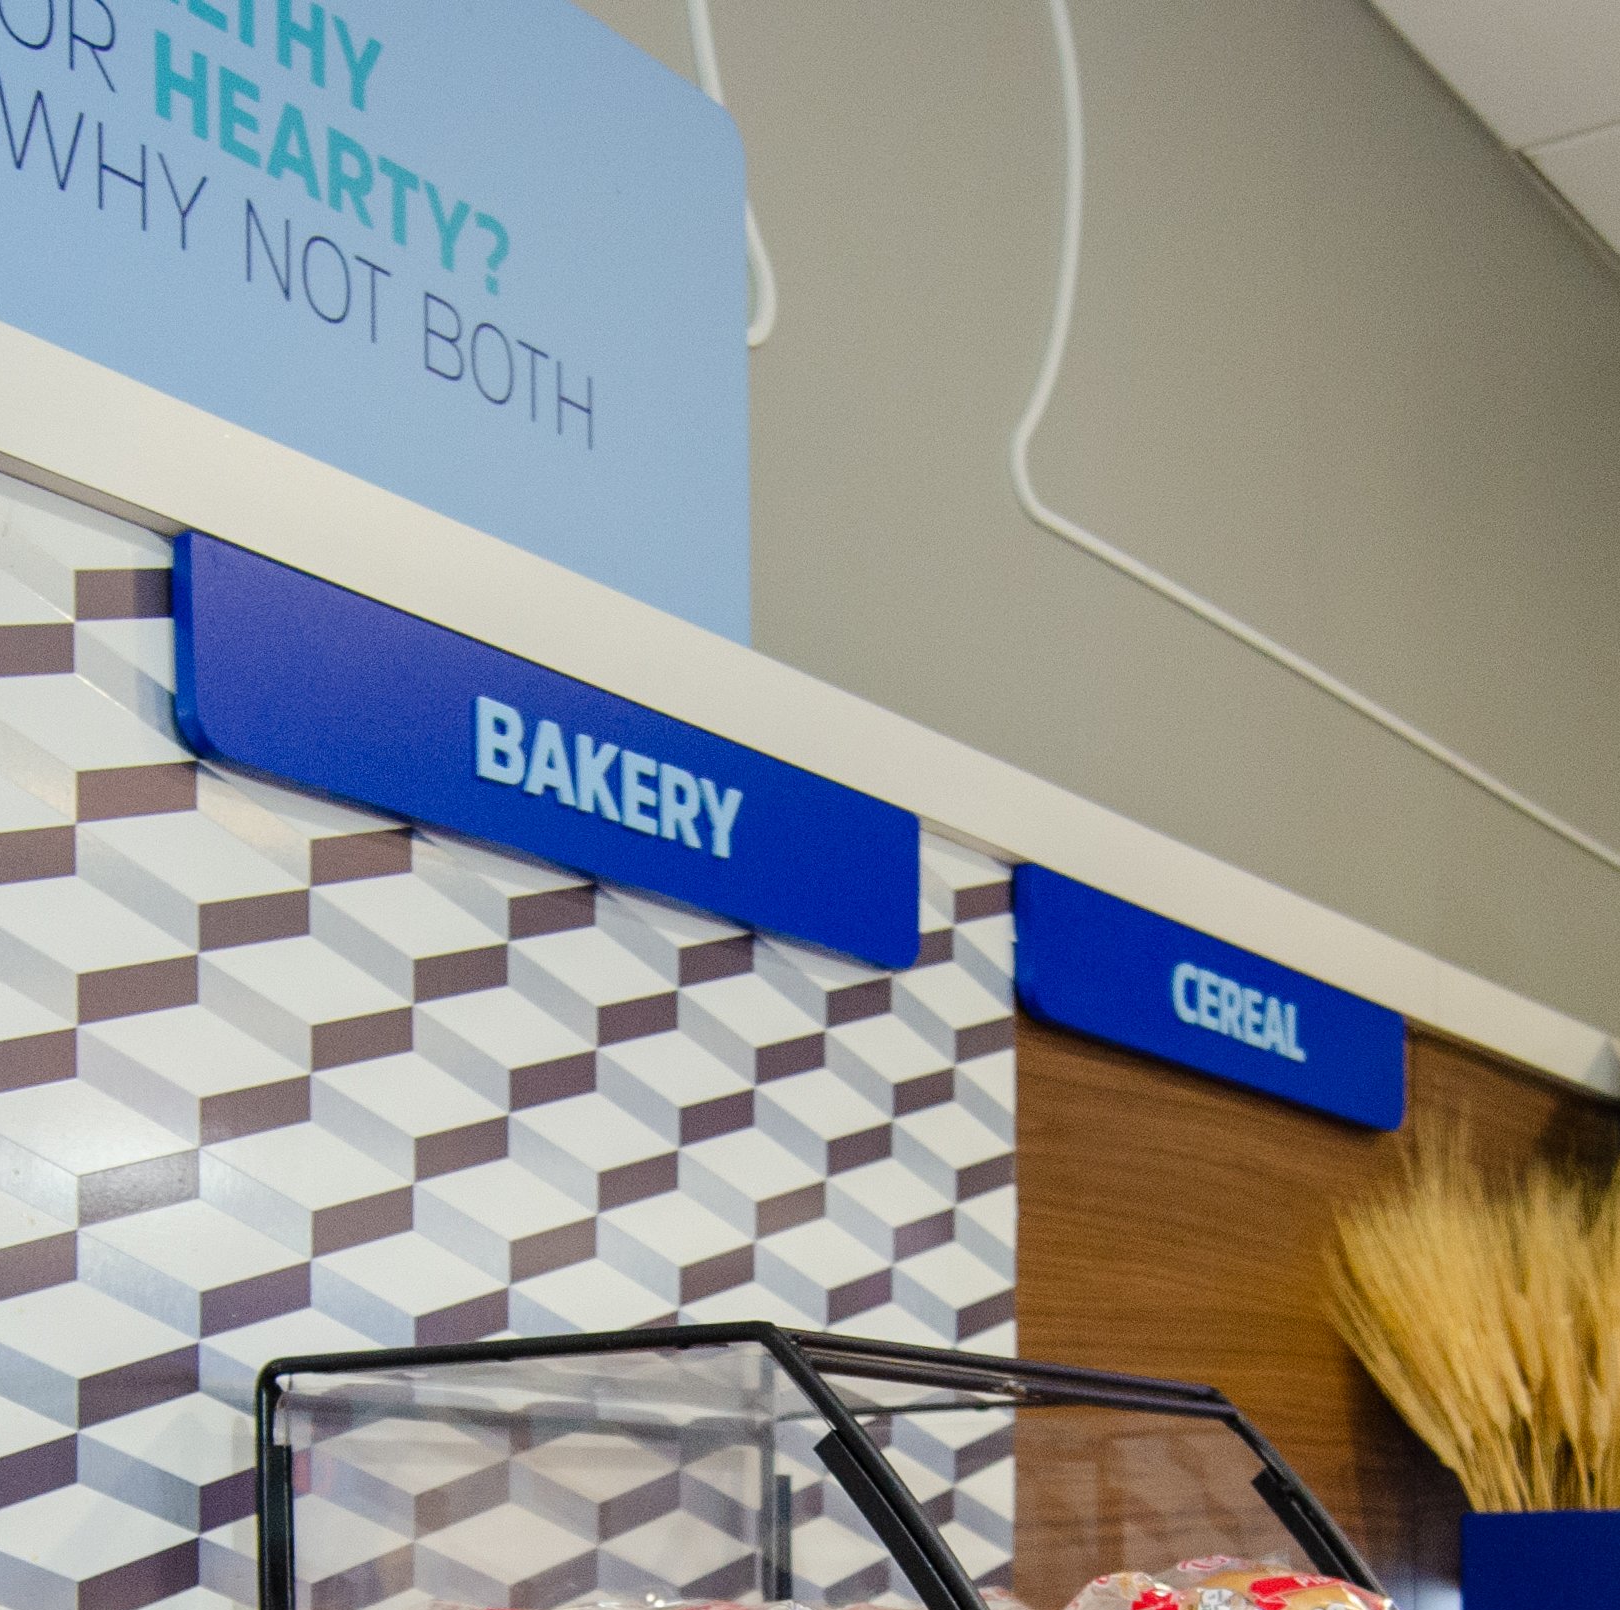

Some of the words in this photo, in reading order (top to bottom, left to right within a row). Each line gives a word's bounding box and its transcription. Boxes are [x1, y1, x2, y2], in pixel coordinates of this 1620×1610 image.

[154, 28, 510, 296] HEARTY?
[246, 199, 391, 344] NOT
[423, 292, 594, 450] BOTH
[475, 695, 744, 859] BAKERY
[1171, 962, 1308, 1064] CEREAL
